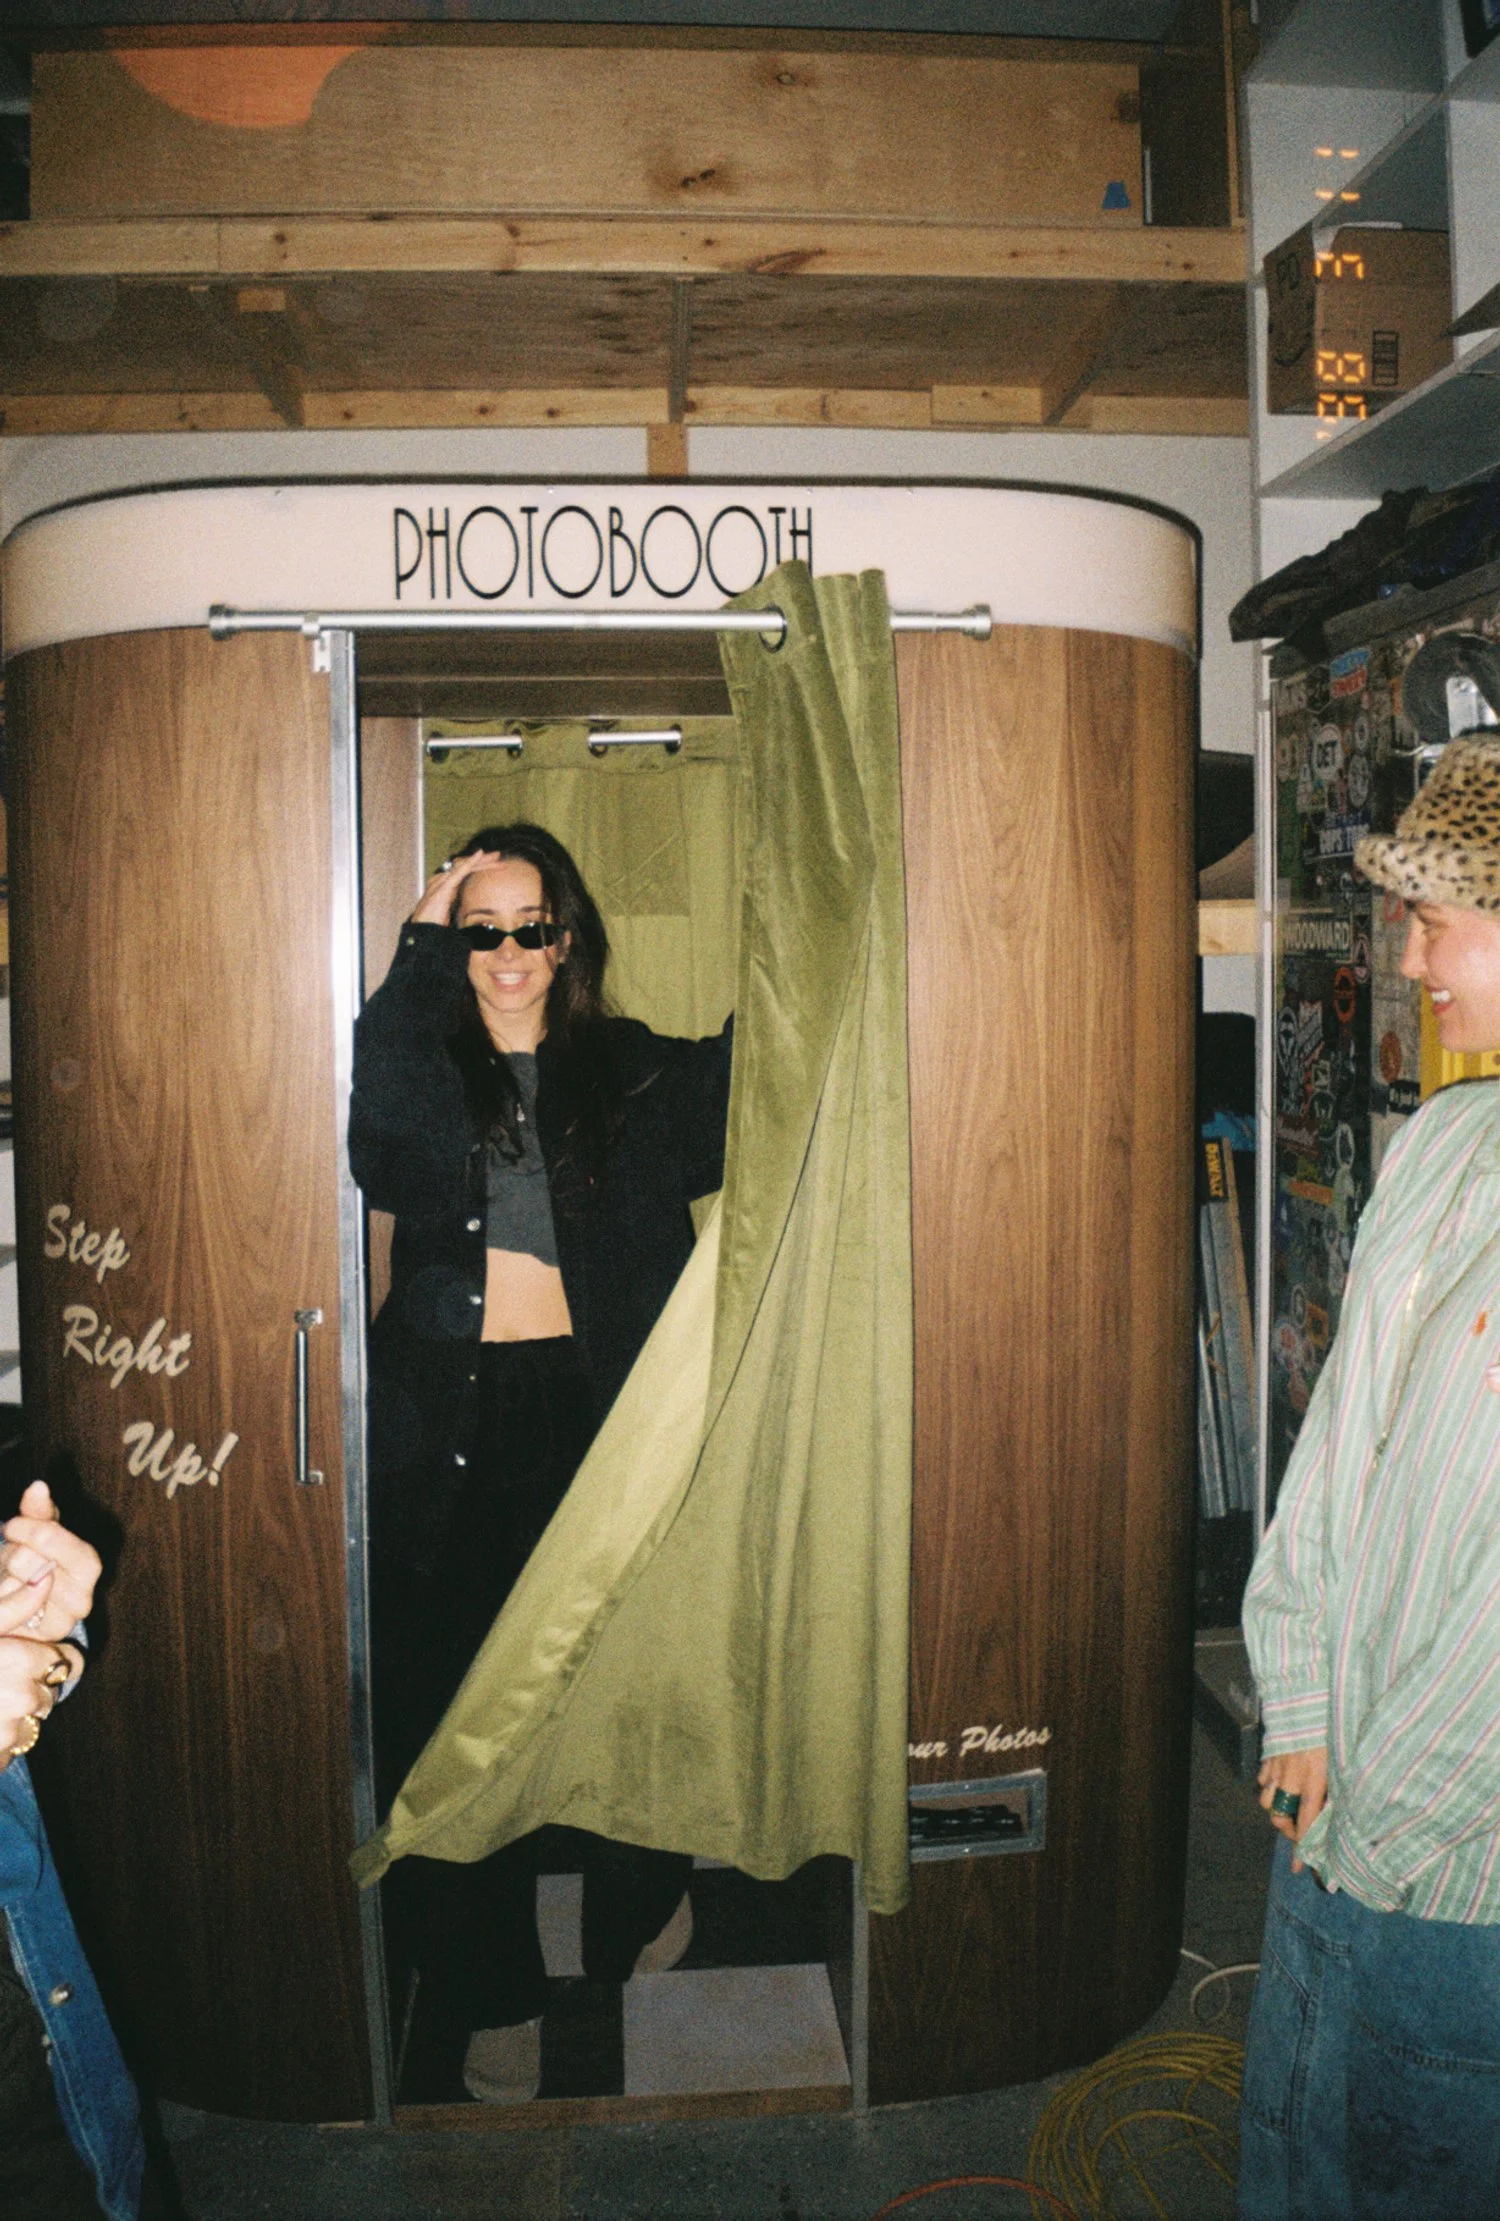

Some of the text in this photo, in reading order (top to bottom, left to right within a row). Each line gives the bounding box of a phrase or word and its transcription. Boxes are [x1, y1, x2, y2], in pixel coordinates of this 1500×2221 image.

[393, 505, 813, 600] PHOTOBOOTH
[1285, 921, 1350, 951] WOODWARD
[43, 1203, 131, 1285] Step
[62, 1304, 192, 1390] Right
[121, 1420, 240, 1500] Up!
[959, 1723, 1053, 1758] Photos
